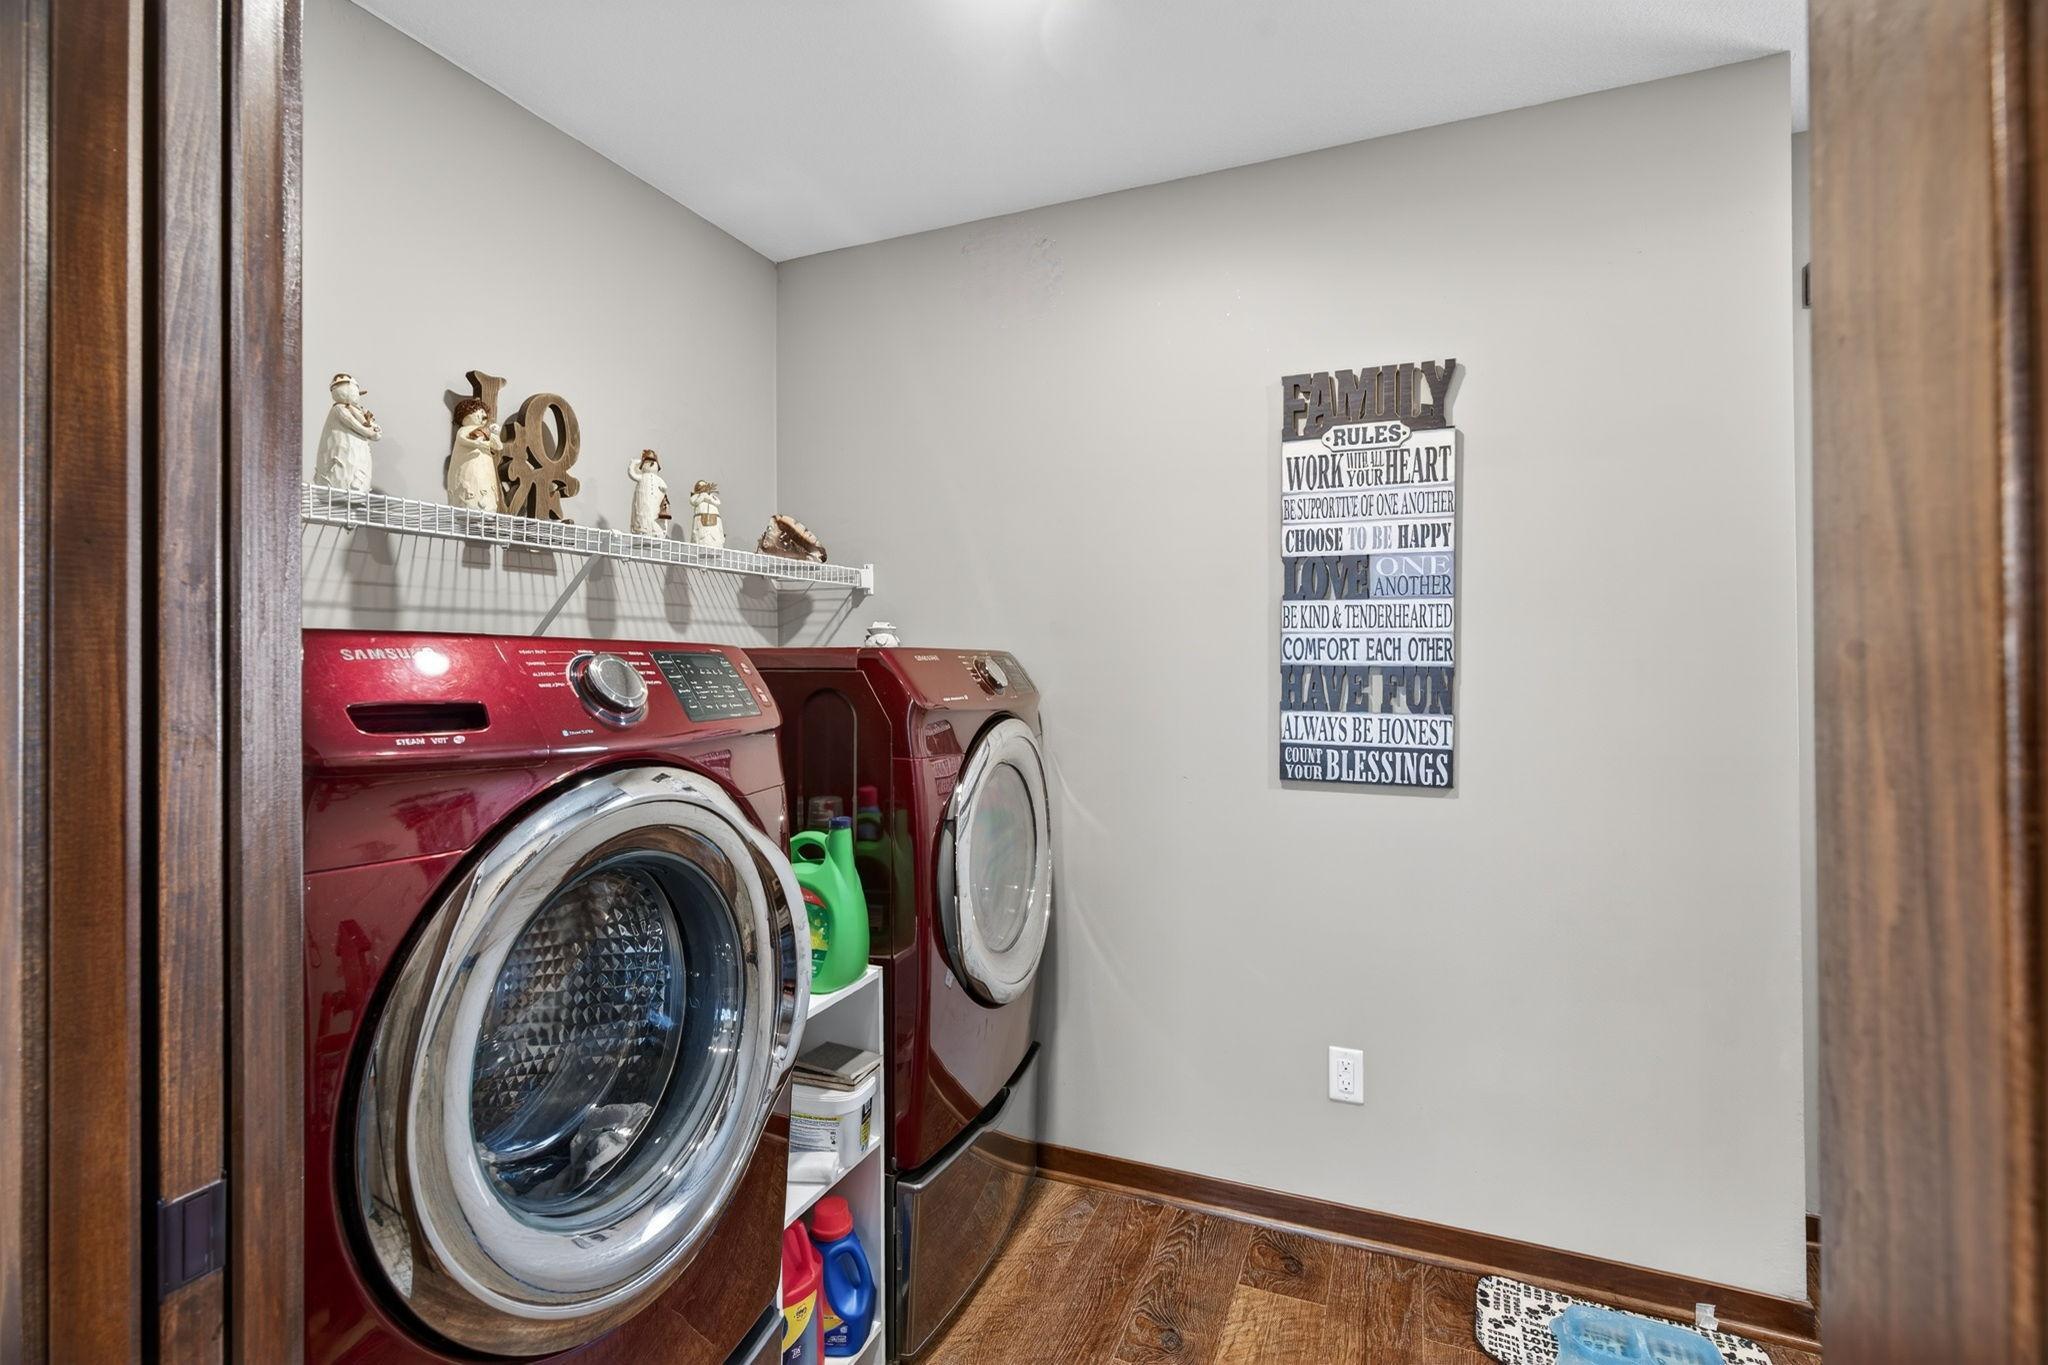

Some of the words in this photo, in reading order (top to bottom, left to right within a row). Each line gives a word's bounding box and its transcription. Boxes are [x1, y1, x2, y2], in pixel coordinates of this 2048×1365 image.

[1282, 358, 1456, 442] FAMILY
[1333, 424, 1403, 446] RULES
[1286, 453, 1344, 491] WORK
[1347, 452, 1368, 469] WITH
[1370, 450, 1384, 468] ALL
[1385, 445, 1452, 485] HEART
[1347, 468, 1384, 487] YOUR
[1283, 499, 1297, 520] BE
[1297, 495, 1359, 520] SUPPORTIVE
[1360, 494, 1375, 517] OF
[1377, 493, 1399, 516] ONE
[1401, 490, 1455, 515] ANOTHER
[1285, 527, 1343, 553] CHOOSE
[1348, 526, 1367, 550] TO
[1372, 525, 1392, 550] BE
[1398, 523, 1452, 549] HAPPY
[1282, 555, 1370, 600] LOVE
[1376, 555, 1450, 576] ONE
[1374, 575, 1453, 596] ANOTHER
[1283, 605, 1297, 629] BE
[1300, 605, 1330, 629] KIND
[1332, 606, 1342, 628] &
[1344, 603, 1453, 629] TENDERHEARTED
[1282, 637, 1360, 661] COMFORT
[1366, 637, 1401, 661] EACH
[1408, 637, 1453, 662] OTHER
[1281, 665, 1369, 712] HAVE
[1380, 666, 1454, 715] FUN
[1282, 715, 1347, 742] ALWAYS
[1352, 717, 1373, 743] BE
[1378, 717, 1452, 746] HONEST
[1285, 746, 1322, 763] COUNT
[1326, 749, 1448, 787] BLESSINGS
[1285, 764, 1322, 780] YOUR
